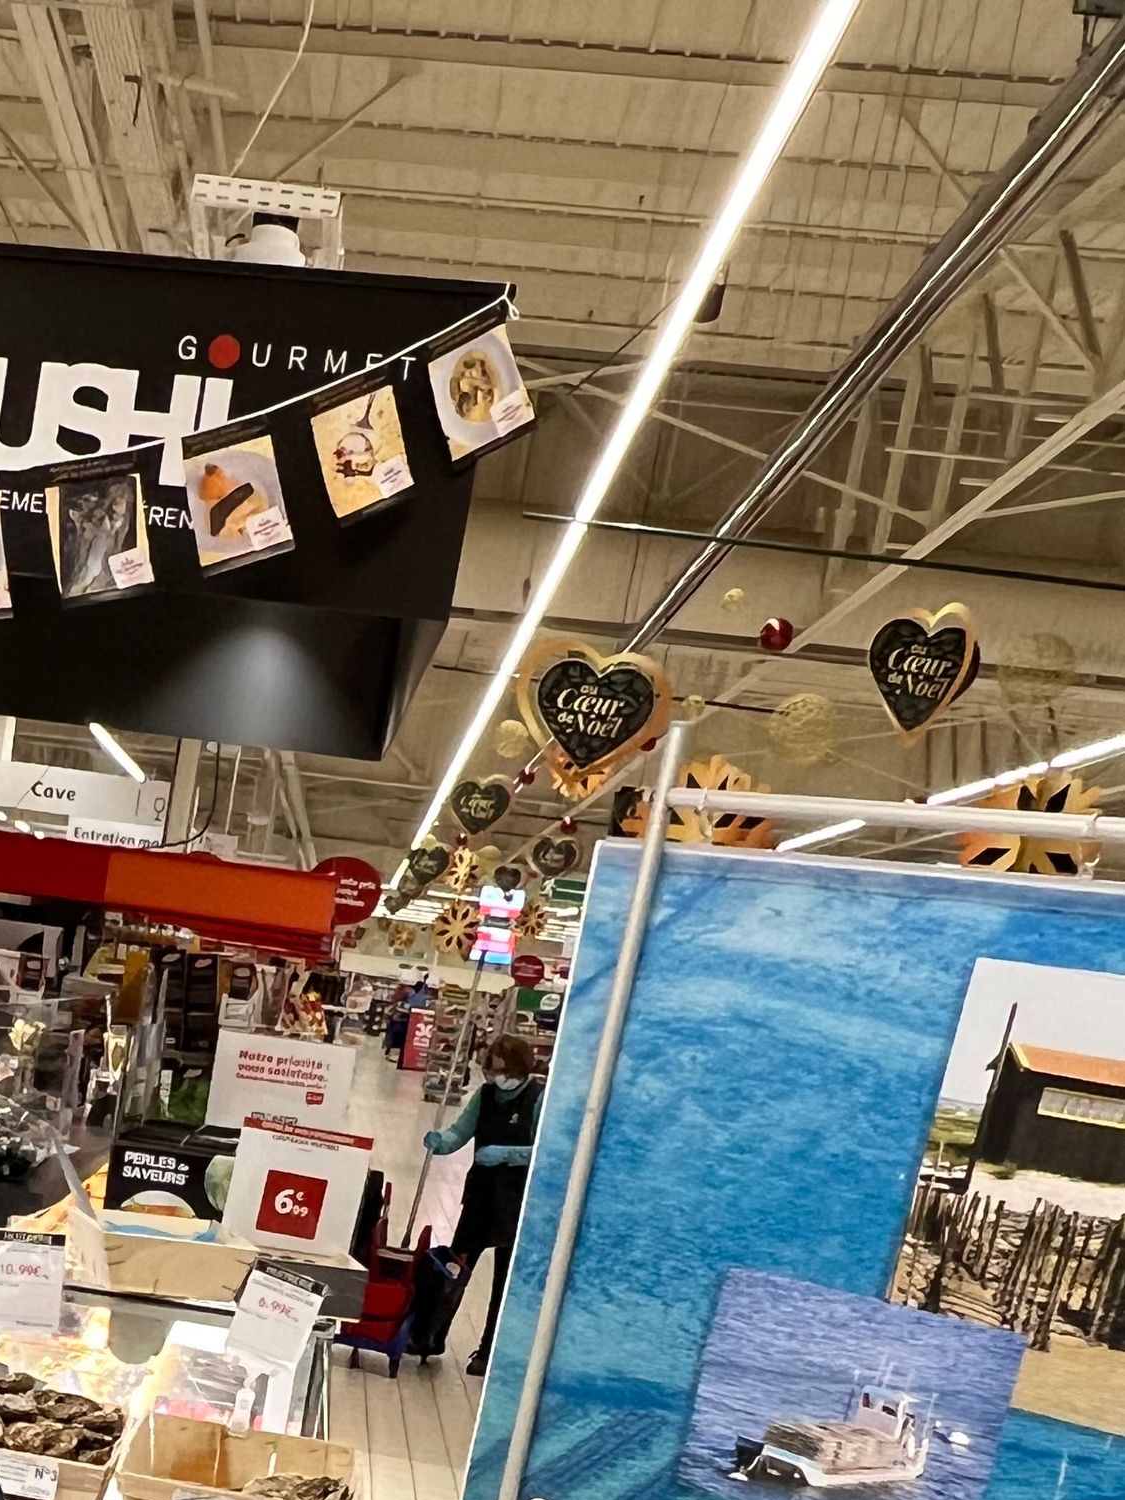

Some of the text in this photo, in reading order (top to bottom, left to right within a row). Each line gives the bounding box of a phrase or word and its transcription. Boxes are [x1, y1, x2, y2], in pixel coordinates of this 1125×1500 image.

[30, 780, 77, 801] Cave
[124, 1151, 177, 1171] PERLES
[121, 1165, 187, 1186] SAVEURS
